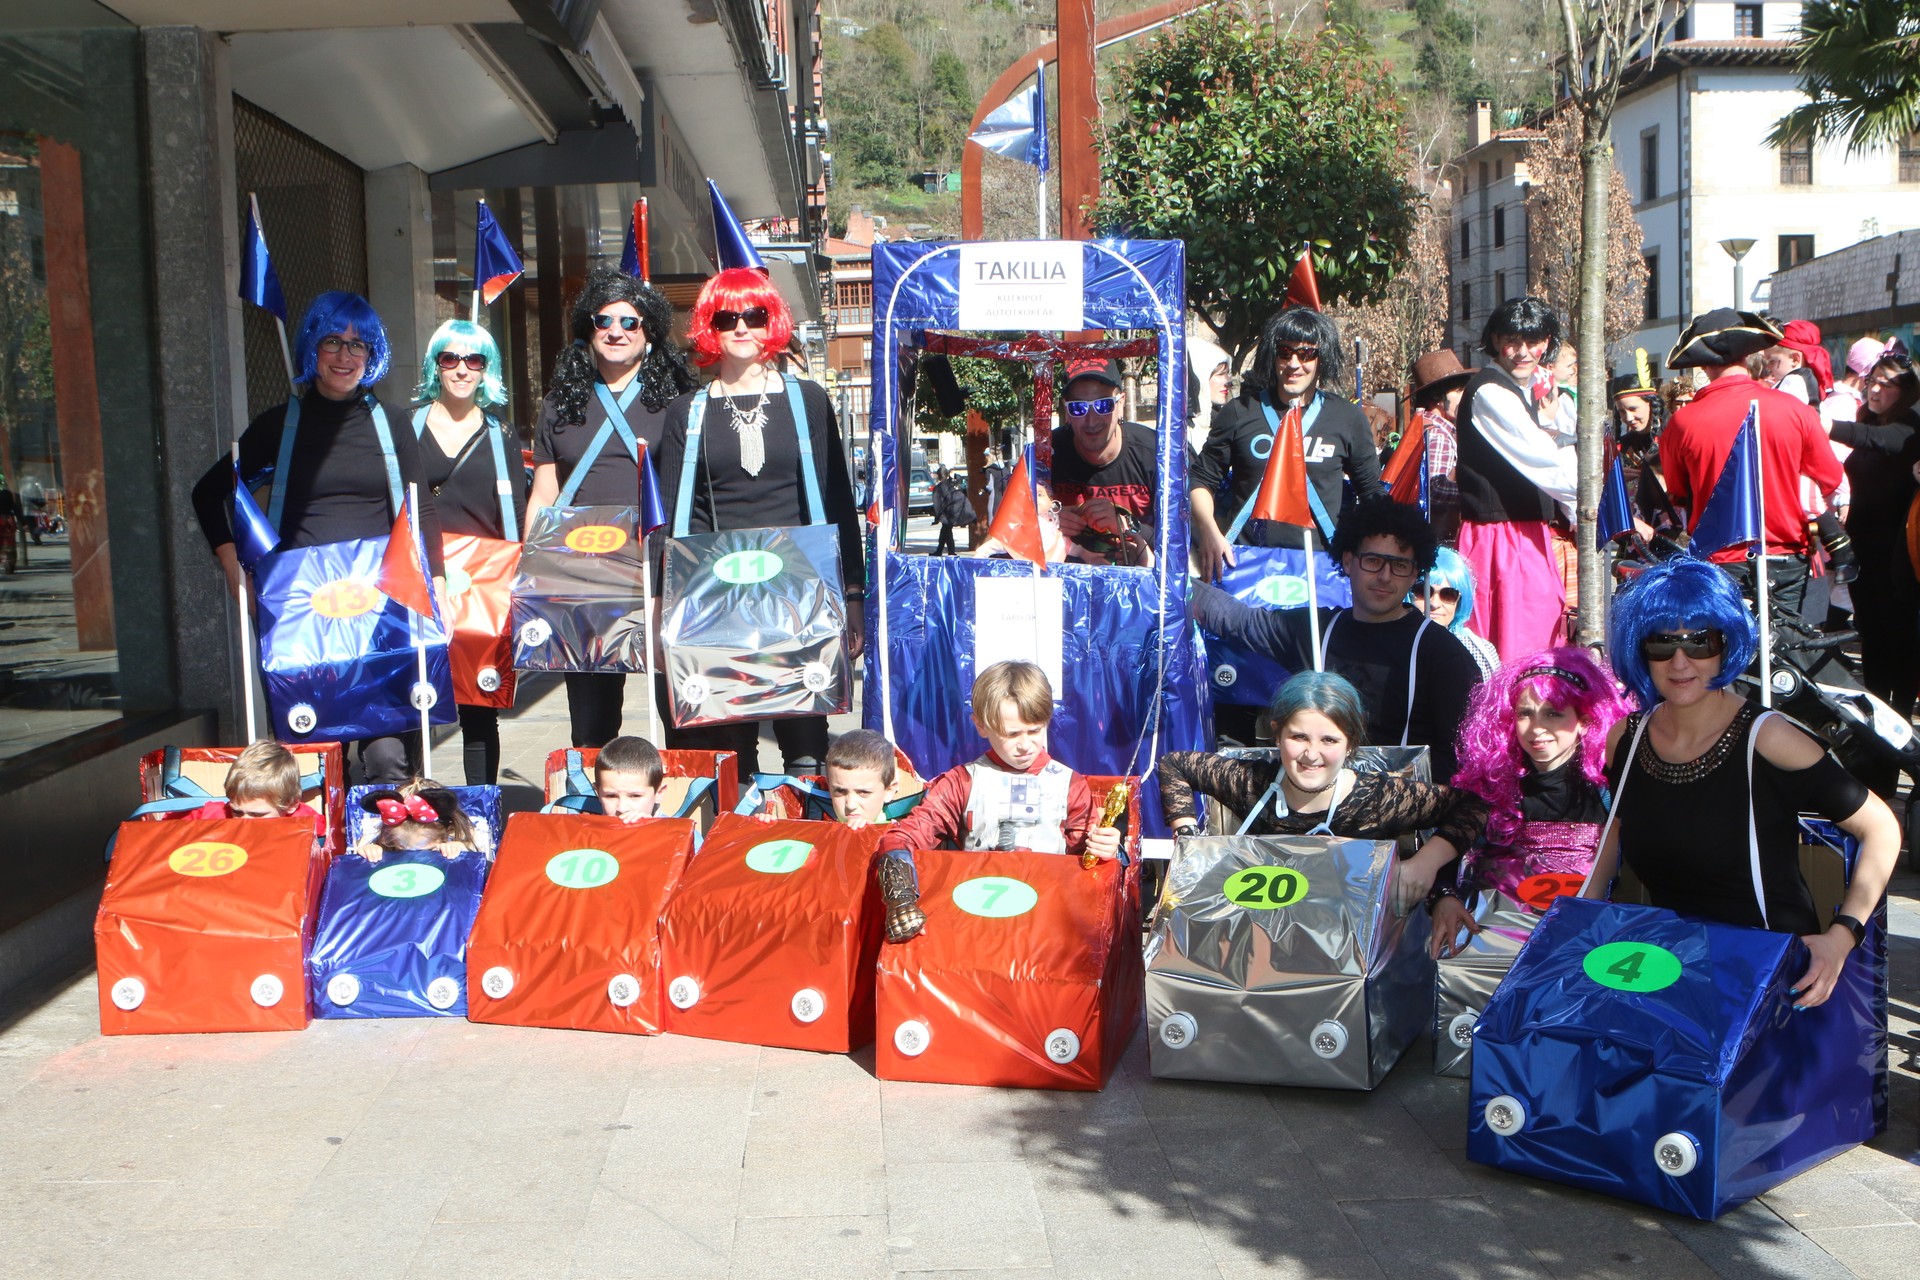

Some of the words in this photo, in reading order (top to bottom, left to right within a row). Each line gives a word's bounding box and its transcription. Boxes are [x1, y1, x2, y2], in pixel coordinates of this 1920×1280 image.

[974, 261, 1067, 280] TAKILIA
[574, 529, 619, 550] 69
[723, 555, 768, 579] 11
[321, 582, 370, 615] 13
[1266, 580, 1305, 601] 12
[179, 848, 235, 872] 26
[770, 846, 789, 868] 1
[391, 870, 417, 892] 3
[558, 856, 608, 884] 10
[979, 884, 1009, 910] 7
[1240, 872, 1298, 904] 20
[1606, 951, 1645, 984] 4
